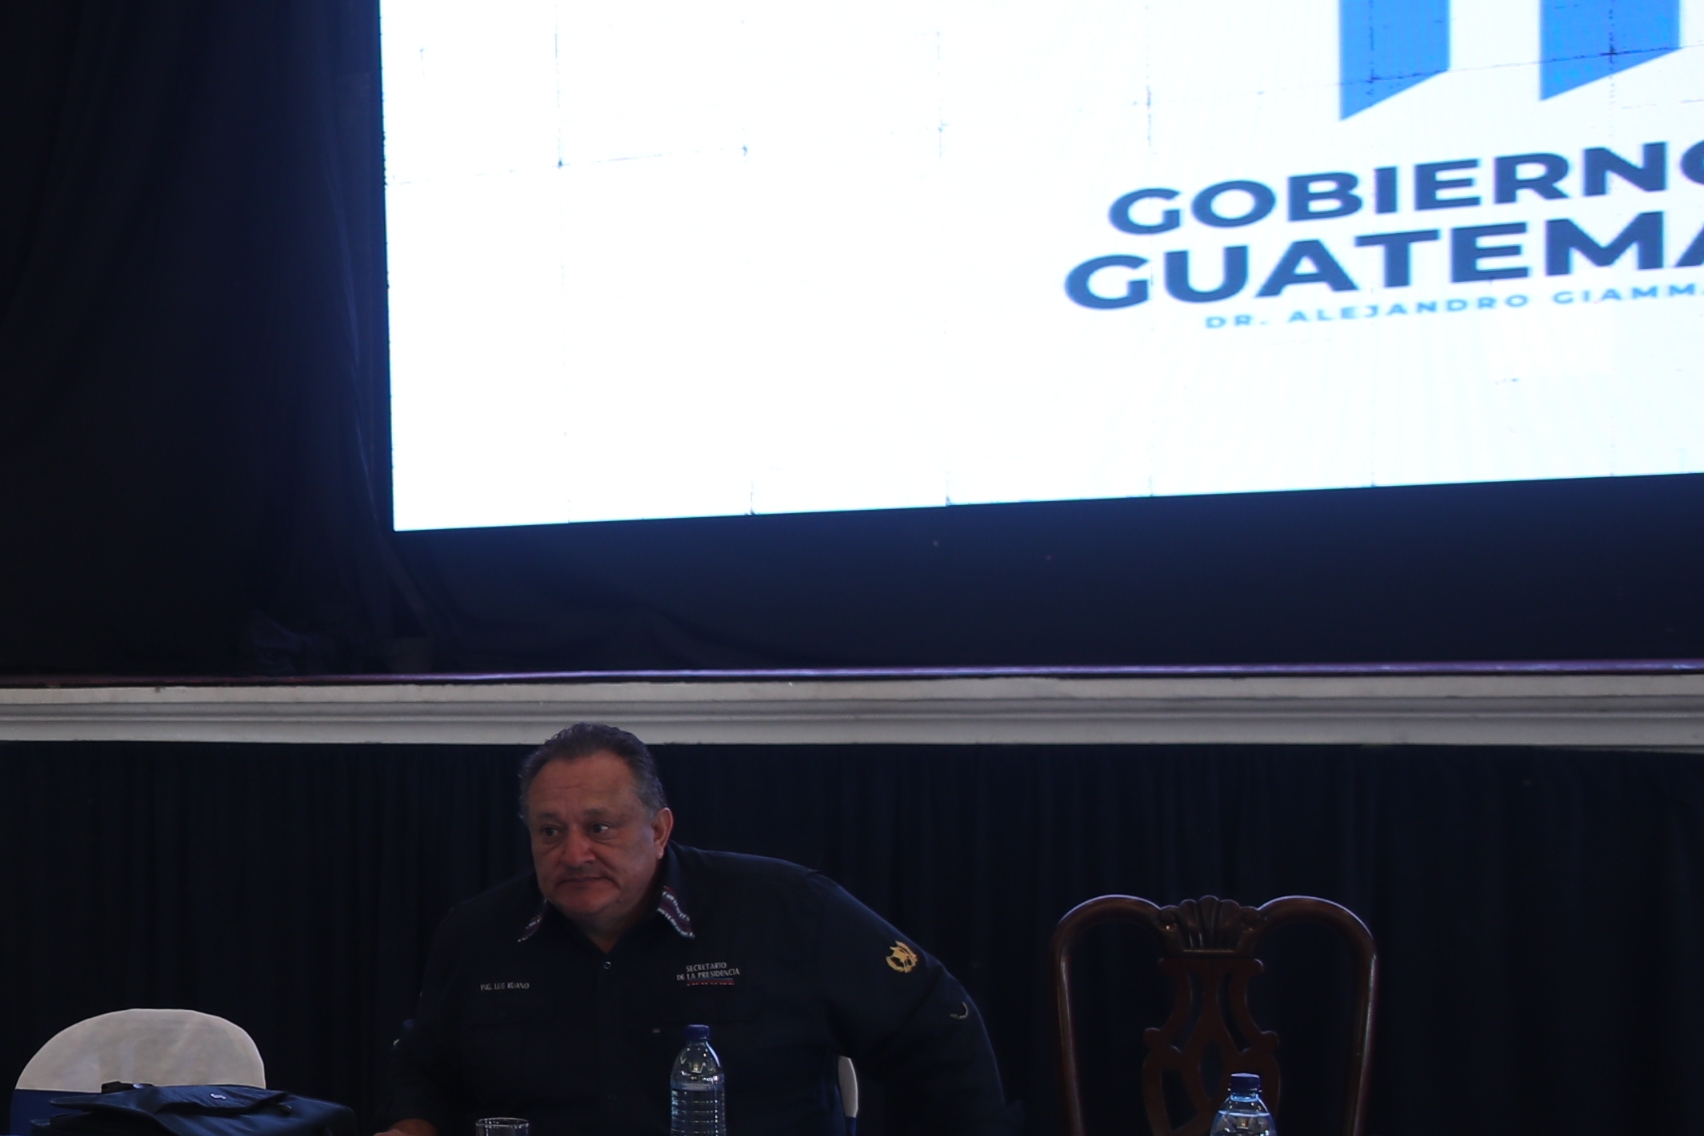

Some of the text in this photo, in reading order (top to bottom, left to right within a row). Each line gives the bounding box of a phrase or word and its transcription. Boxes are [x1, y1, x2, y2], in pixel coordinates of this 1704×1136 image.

[1107, 136, 1704, 236] GOBIERN
[1204, 282, 1704, 330] DR. ALEJANDRO GIAMM
[676, 967, 741, 981] DE LA PRESIDENCIA
[686, 962, 727, 973] SECRETARIO
